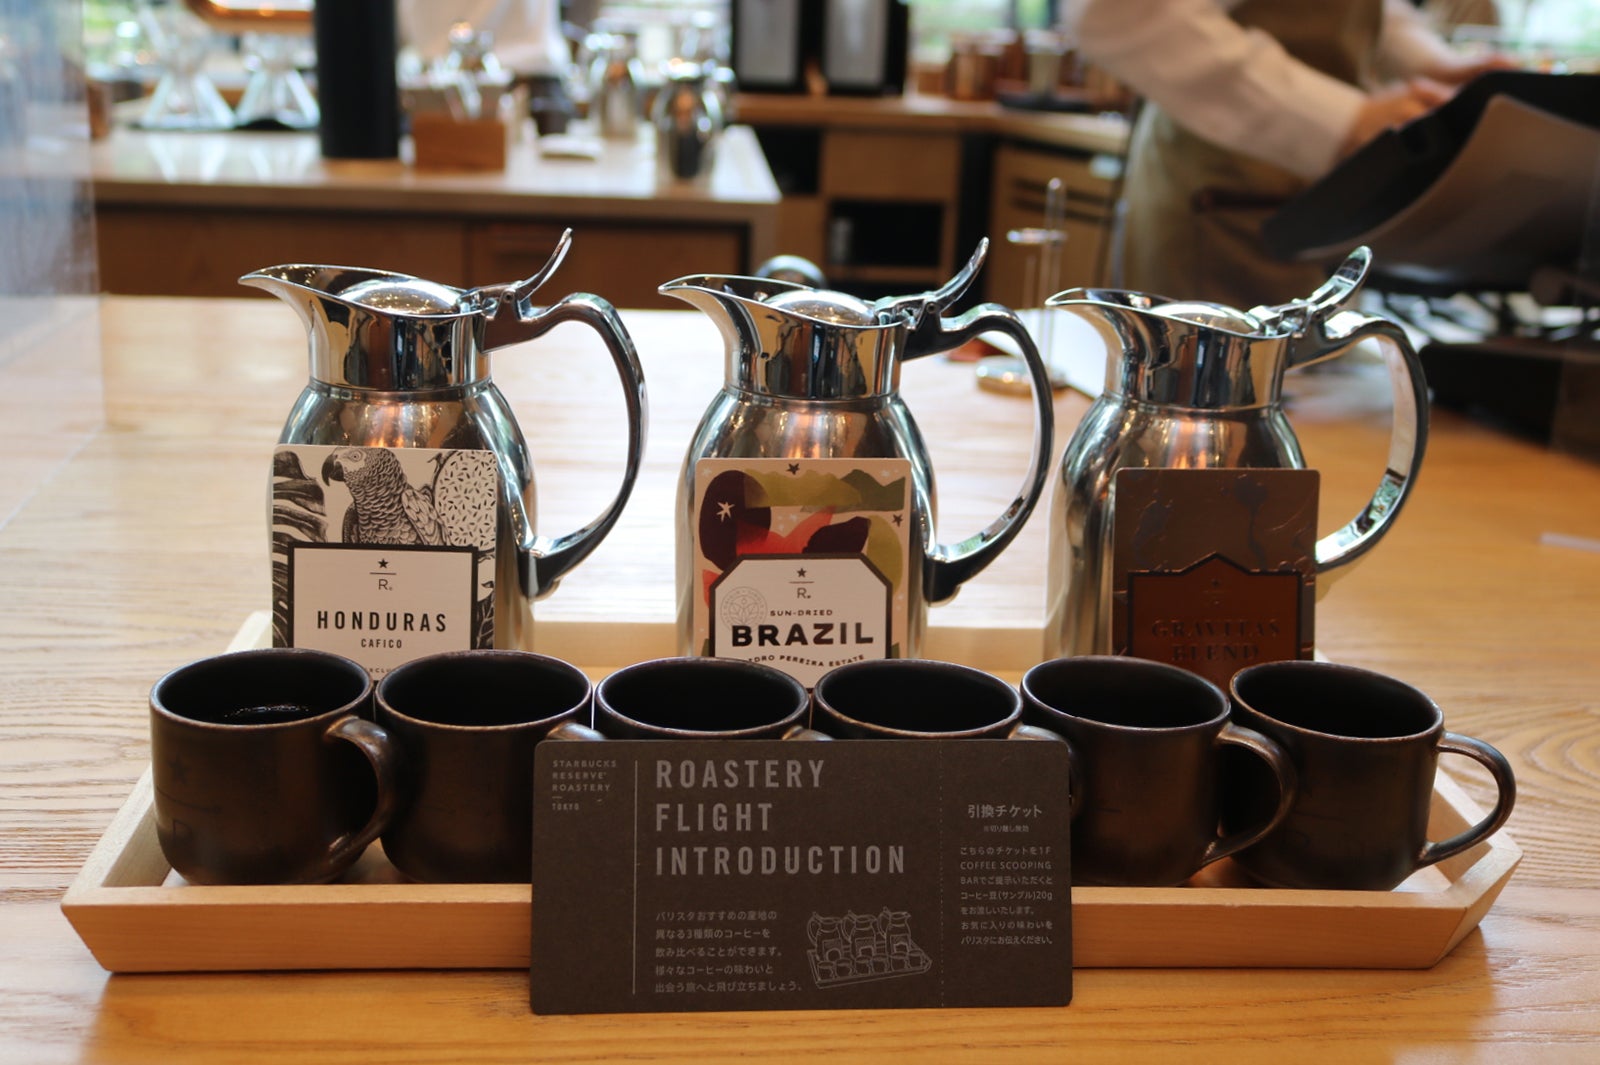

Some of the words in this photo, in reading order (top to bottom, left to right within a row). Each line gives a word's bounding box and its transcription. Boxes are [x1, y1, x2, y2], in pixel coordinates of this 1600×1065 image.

[770, 609, 833, 617] SUN-DRIED
[317, 611, 447, 632] HONDURAS
[1151, 618, 1280, 637] GRAVITAS
[732, 622, 874, 647] BRAZIL
[361, 639, 402, 649] CAFICO
[1171, 643, 1259, 661] BLEND
[779, 655, 824, 667] PEREIRA
[829, 654, 864, 667] ESTATE
[552, 760, 617, 768] STARBUCKS
[656, 760, 825, 789] ROASTERY
[552, 784, 611, 792] ROASTERY
[552, 803, 580, 811] TOKYO
[968, 804, 1042, 819] 引換チケット
[656, 803, 773, 832] FLIGHT
[655, 845, 905, 875] INTRODUCTION
[960, 861, 997, 870] COFFEE
[1000, 861, 1052, 870] SCOOPING
[656, 911, 777, 921] バリスタおすすめの産地の
[961, 921, 1053, 930] お気に入りの味わいを
[655, 928, 771, 939] 異なる3種類のコーヒーを
[655, 965, 774, 976] 様々なコーヒーの味わいと
